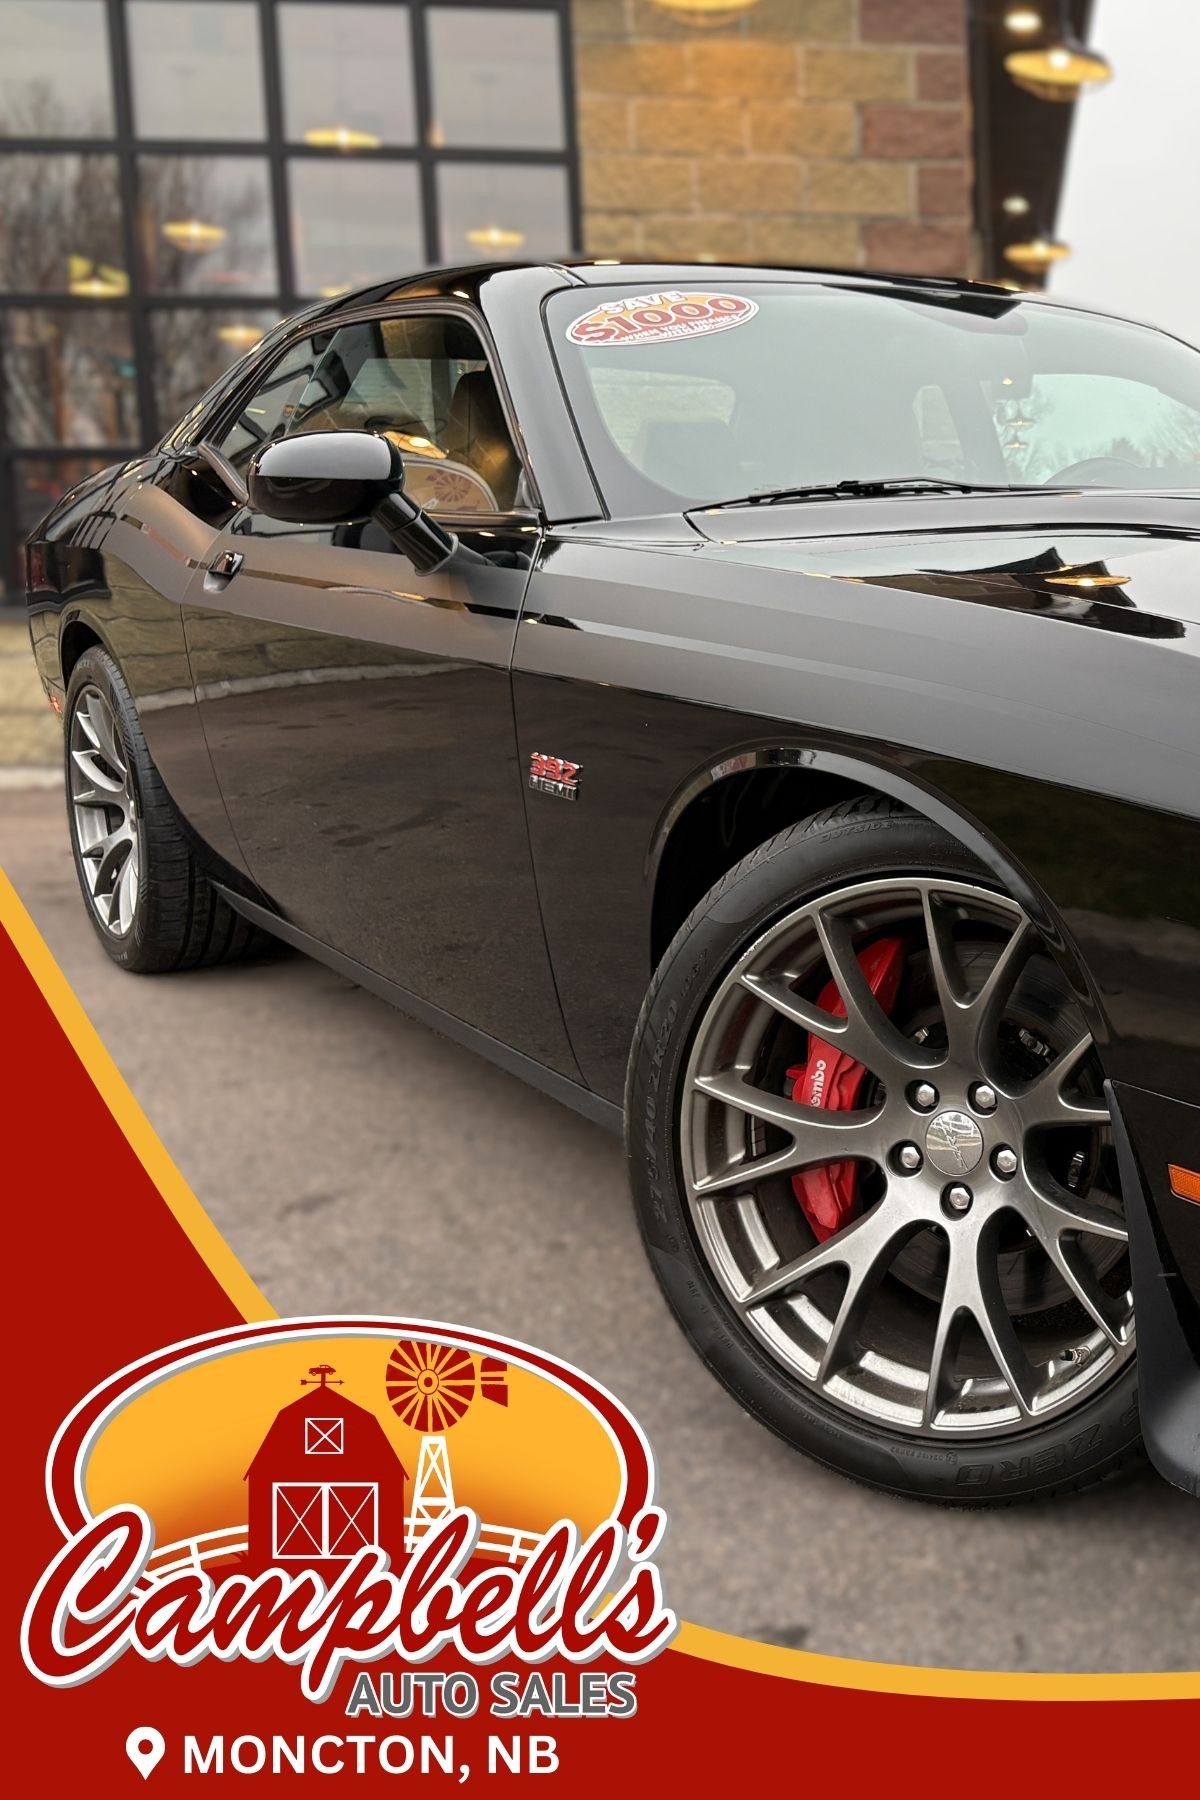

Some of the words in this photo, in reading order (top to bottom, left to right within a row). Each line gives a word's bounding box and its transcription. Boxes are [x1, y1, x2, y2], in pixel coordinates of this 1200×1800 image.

[573, 297, 748, 342] $1000
[601, 291, 688, 314] SAVE
[621, 329, 660, 341] WHEN
[661, 321, 690, 333] YOU
[530, 752, 580, 786] 392
[529, 774, 578, 801] HEMI
[811, 1059, 827, 1107] embo
[954, 1423, 1104, 1486] ZERO
